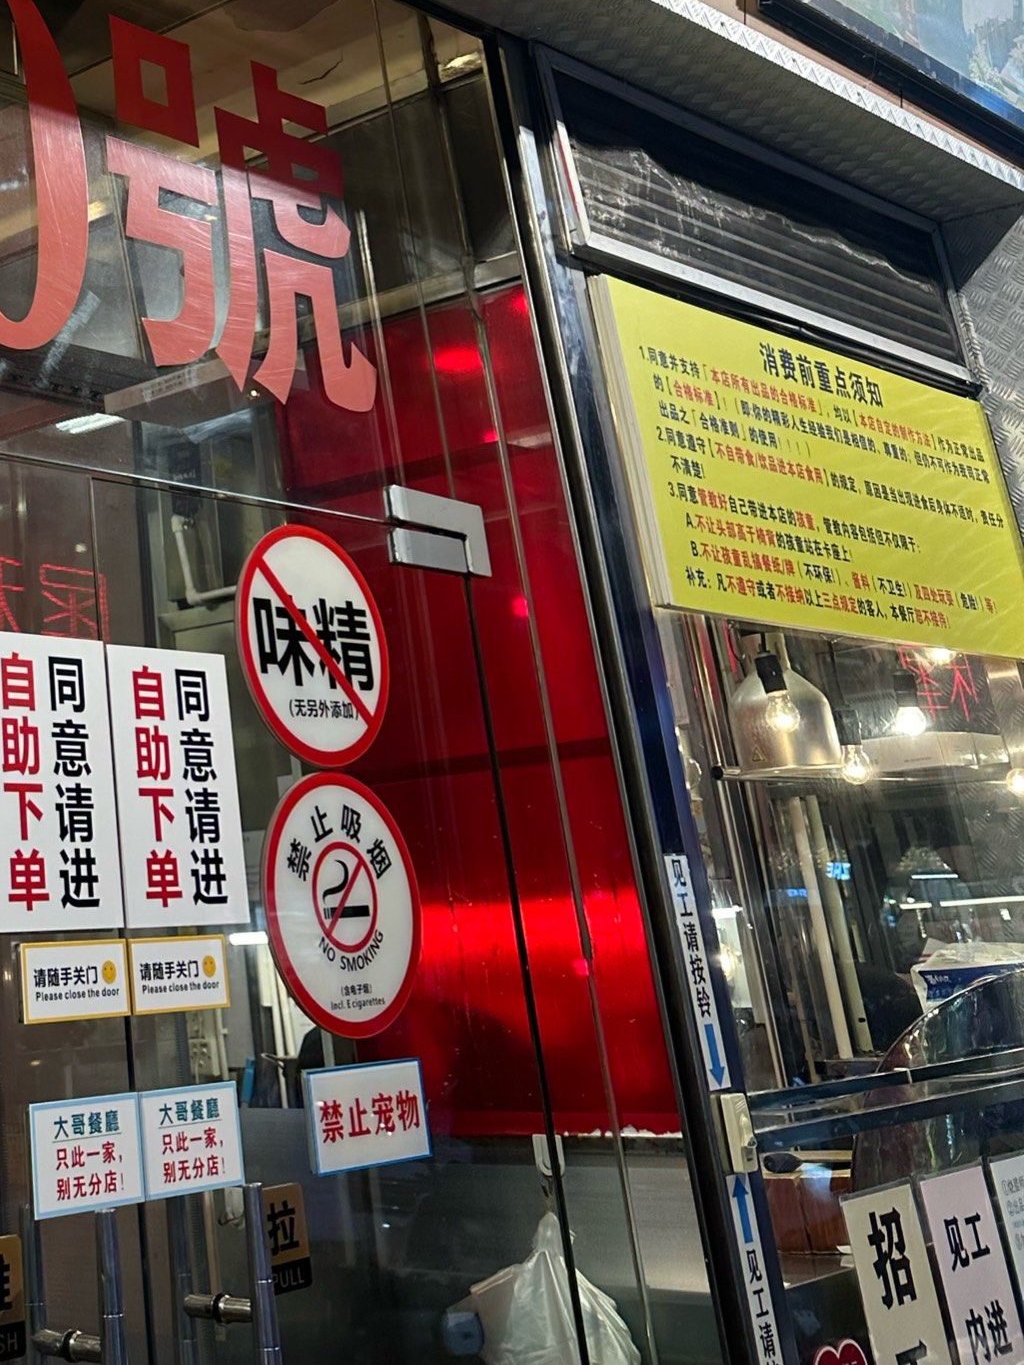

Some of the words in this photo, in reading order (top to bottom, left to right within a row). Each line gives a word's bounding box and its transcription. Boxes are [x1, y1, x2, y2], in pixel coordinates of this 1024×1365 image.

[759, 342, 884, 408] 消费前重点须知
[254, 595, 375, 691] 味精
[289, 699, 359, 721] （无另外添加）
[1, 653, 50, 911] 自助下单
[48, 656, 100, 911] 同意请进
[132, 666, 183, 909] 自助下单
[176, 669, 229, 907] 同意请进
[286, 804, 392, 882] 禁止吸烟
[319, 936, 336, 963] NO
[340, 929, 384, 973] SMOKING
[670, 858, 712, 1018] 见工请按铃
[33, 965, 98, 988] 请随手关门
[139, 960, 199, 981] 请随手关门
[142, 983, 167, 994] Please
[169, 982, 188, 992] close
[190, 981, 201, 991] the
[202, 980, 220, 990] door
[36, 990, 63, 1002] Please
[65, 989, 86, 1000] close
[88, 988, 100, 998] the
[101, 987, 120, 997] door
[330, 998, 346, 1011] Incl.
[352, 996, 386, 1010] cigarettes
[54, 1110, 120, 1139] 大哥餐廳
[159, 1098, 220, 1125] 大哥餐廳
[319, 1089, 420, 1145] 禁止宠物
[56, 1141, 123, 1171] 只此一家，
[162, 1127, 224, 1155] 只此一家，
[57, 1170, 125, 1201] 别无分店！
[163, 1155, 226, 1184] 别无分店！
[266, 1199, 300, 1257] 拉
[943, 1212, 991, 1272] 见工
[746, 1249, 780, 1365] 见工请
